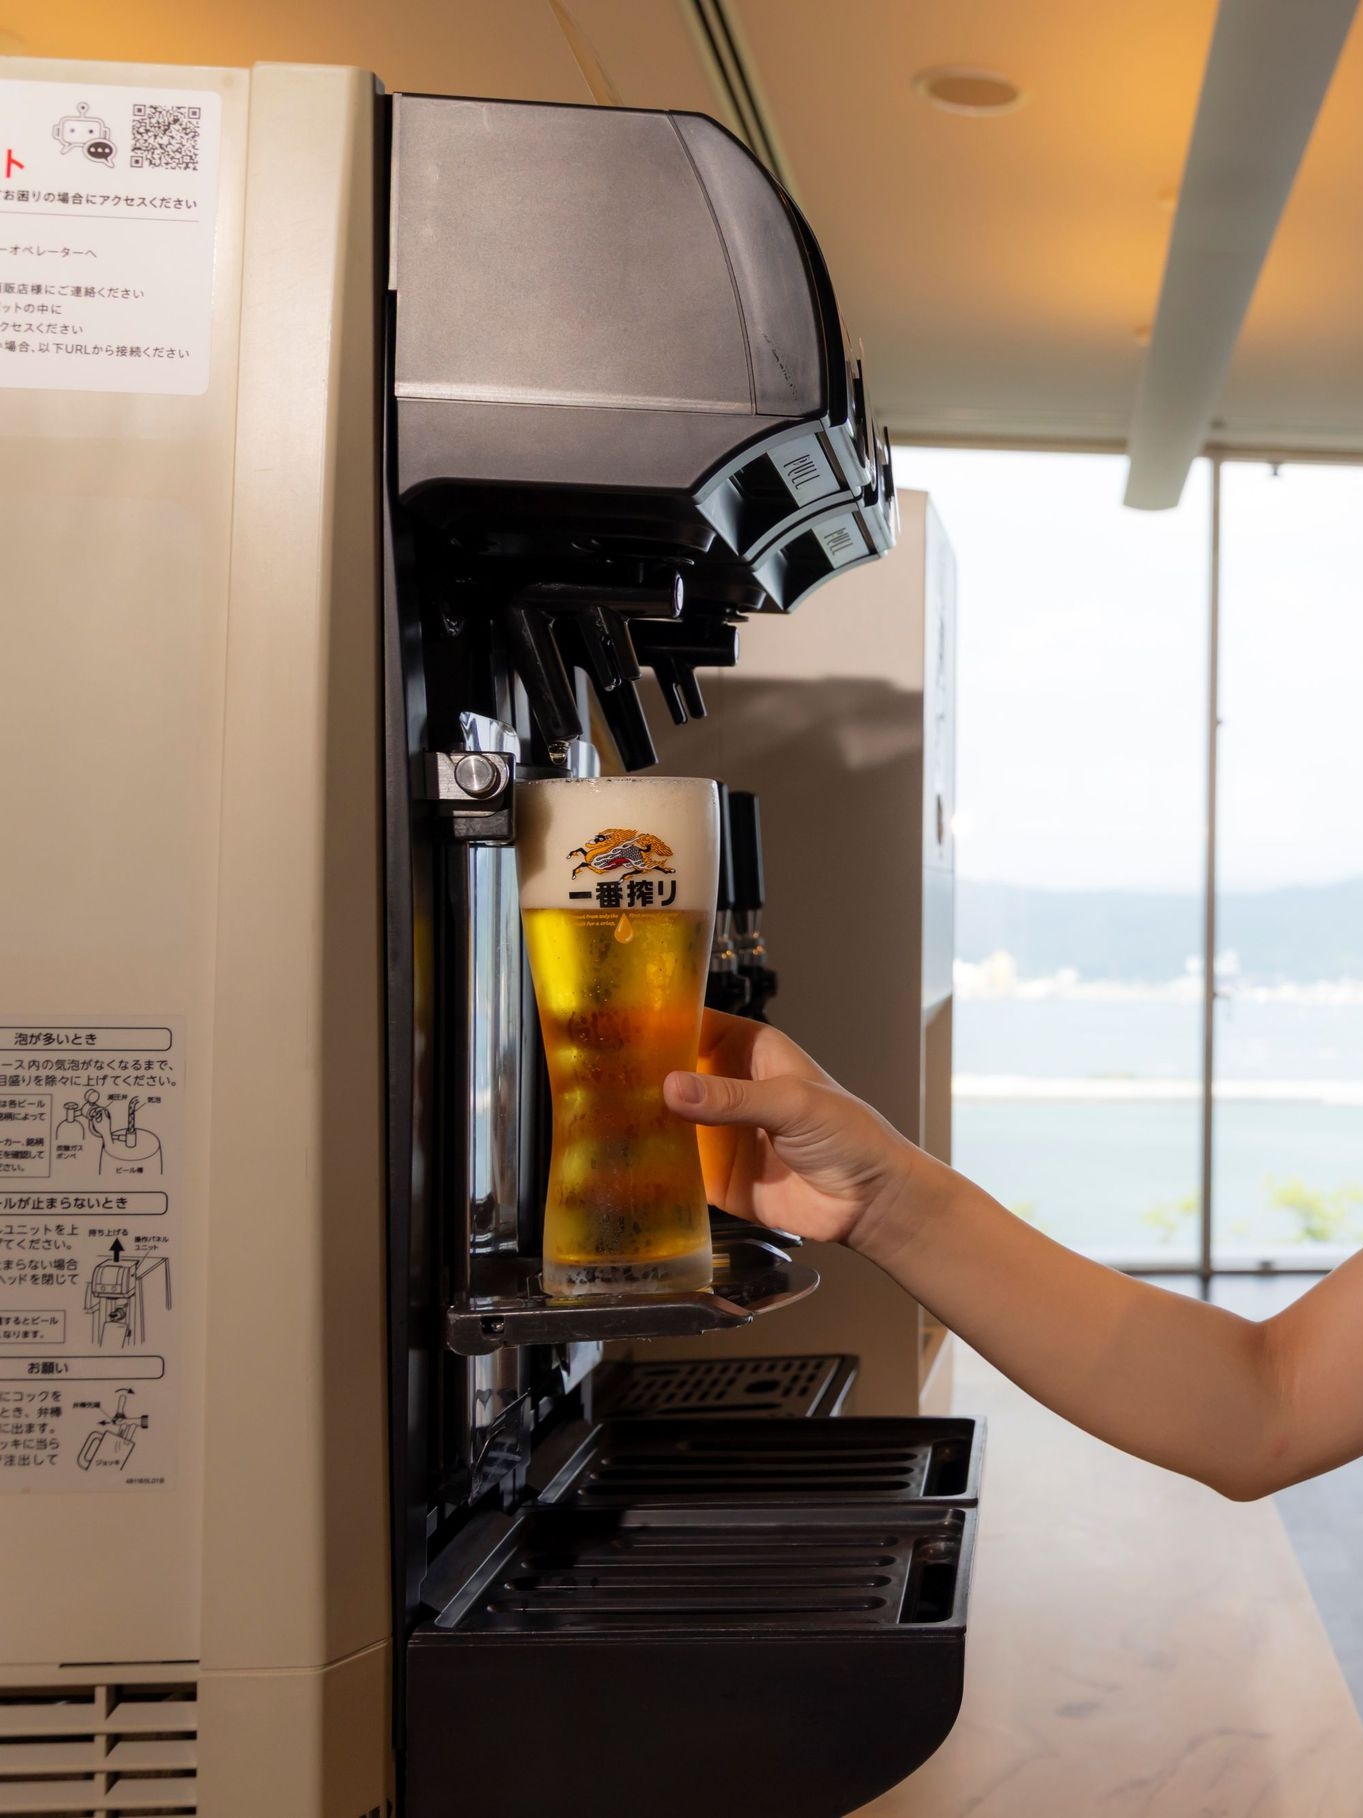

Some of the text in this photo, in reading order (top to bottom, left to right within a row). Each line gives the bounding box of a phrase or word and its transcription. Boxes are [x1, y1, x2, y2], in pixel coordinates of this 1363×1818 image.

[6, 149, 25, 178] ト
[0, 189, 198, 210] お困りの場合にアクセスください
[0, 282, 145, 299] 販店様にご連絡ください
[0, 302, 63, 315] ットの中に
[0, 340, 191, 359] 場合、以下URLから接続ください
[783, 453, 821, 490] PULL
[823, 526, 854, 556] PULL
[569, 880, 677, 908] 一番搾り
[14, 1032, 97, 1046] 泡が多いとき
[2, 1059, 174, 1072] ース内の気泡がなくなるまで、
[0, 1197, 128, 1210] ルが止まらないとき
[0, 1224, 79, 1236] ユニットを上
[0, 1238, 73, 1250] てください。
[0, 1258, 78, 1271] まらない場合
[0, 1316, 59, 1325] するとビール
[0, 1330, 44, 1339] なります。
[27, 1361, 69, 1375] お願い
[0, 1453, 59, 1466] 注出して
